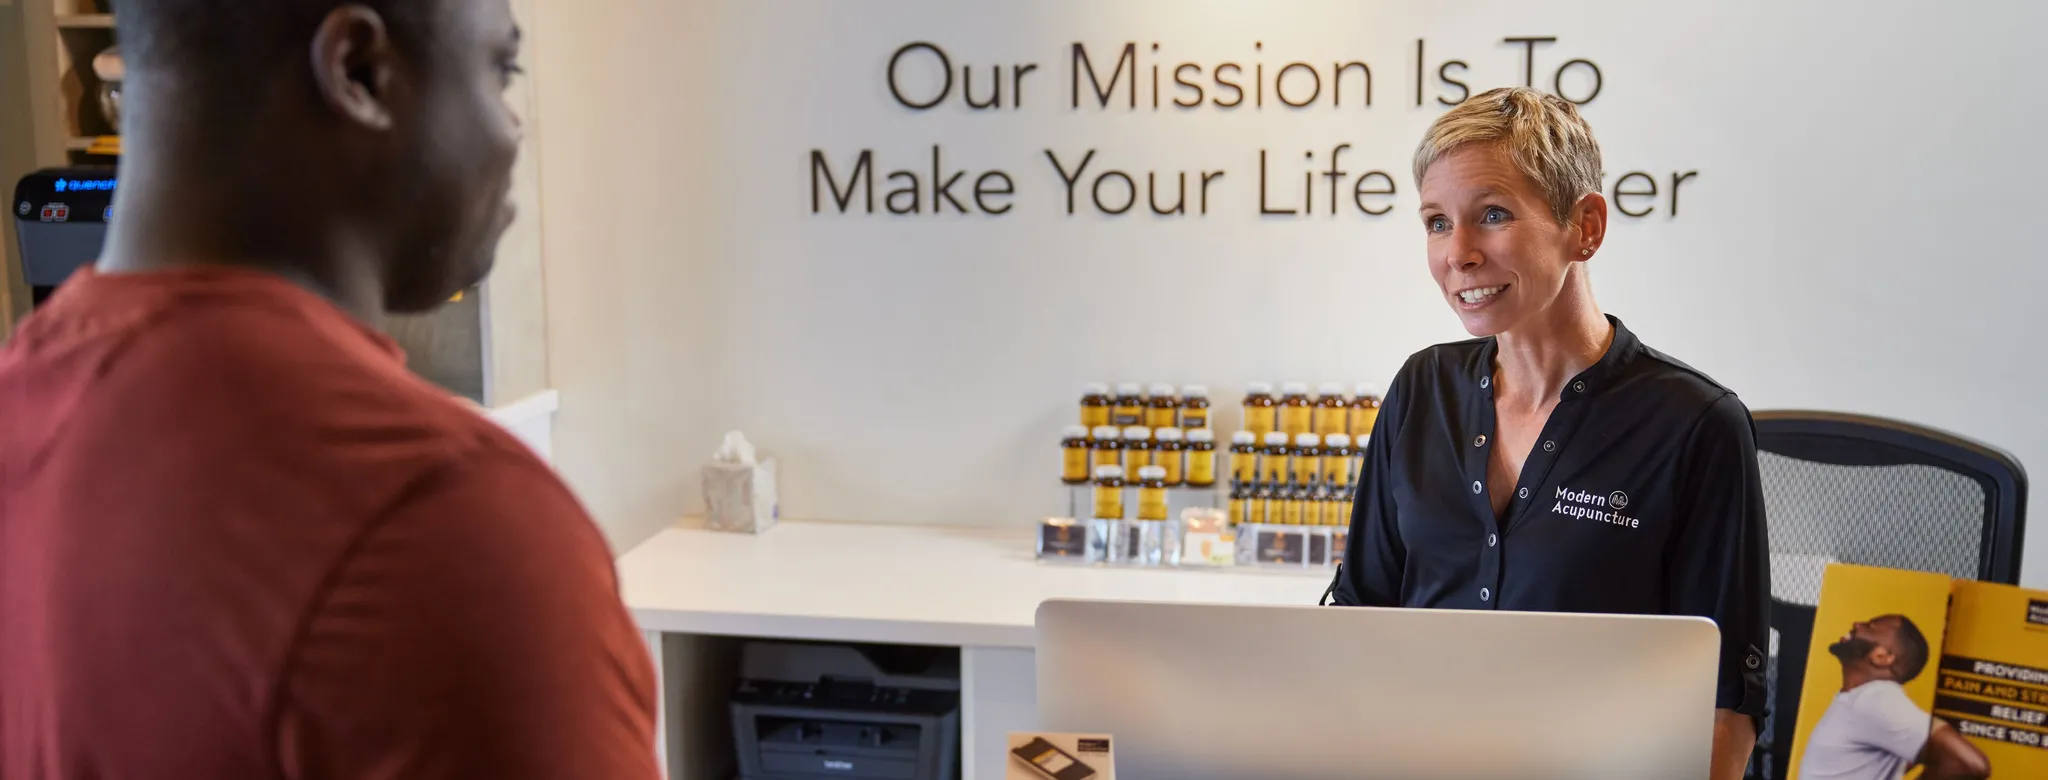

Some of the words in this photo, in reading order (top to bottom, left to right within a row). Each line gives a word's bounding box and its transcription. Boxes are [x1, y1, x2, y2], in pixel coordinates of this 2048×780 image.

[886, 41, 1038, 110] Our
[1072, 41, 1371, 109] Mission
[1416, 39, 1470, 106] Is
[1503, 37, 1603, 105] To
[810, 144, 1015, 216] Make
[1043, 149, 1225, 216] Your
[1260, 144, 1396, 216] Life
[1555, 485, 1606, 507] Modern
[1551, 500, 1640, 529] Acupuncture
[1944, 676, 1981, 693] PAIN
[1984, 683, 2018, 698] AND
[1990, 705, 2046, 724] RELIEF
[1960, 720, 2006, 740] SINCE
